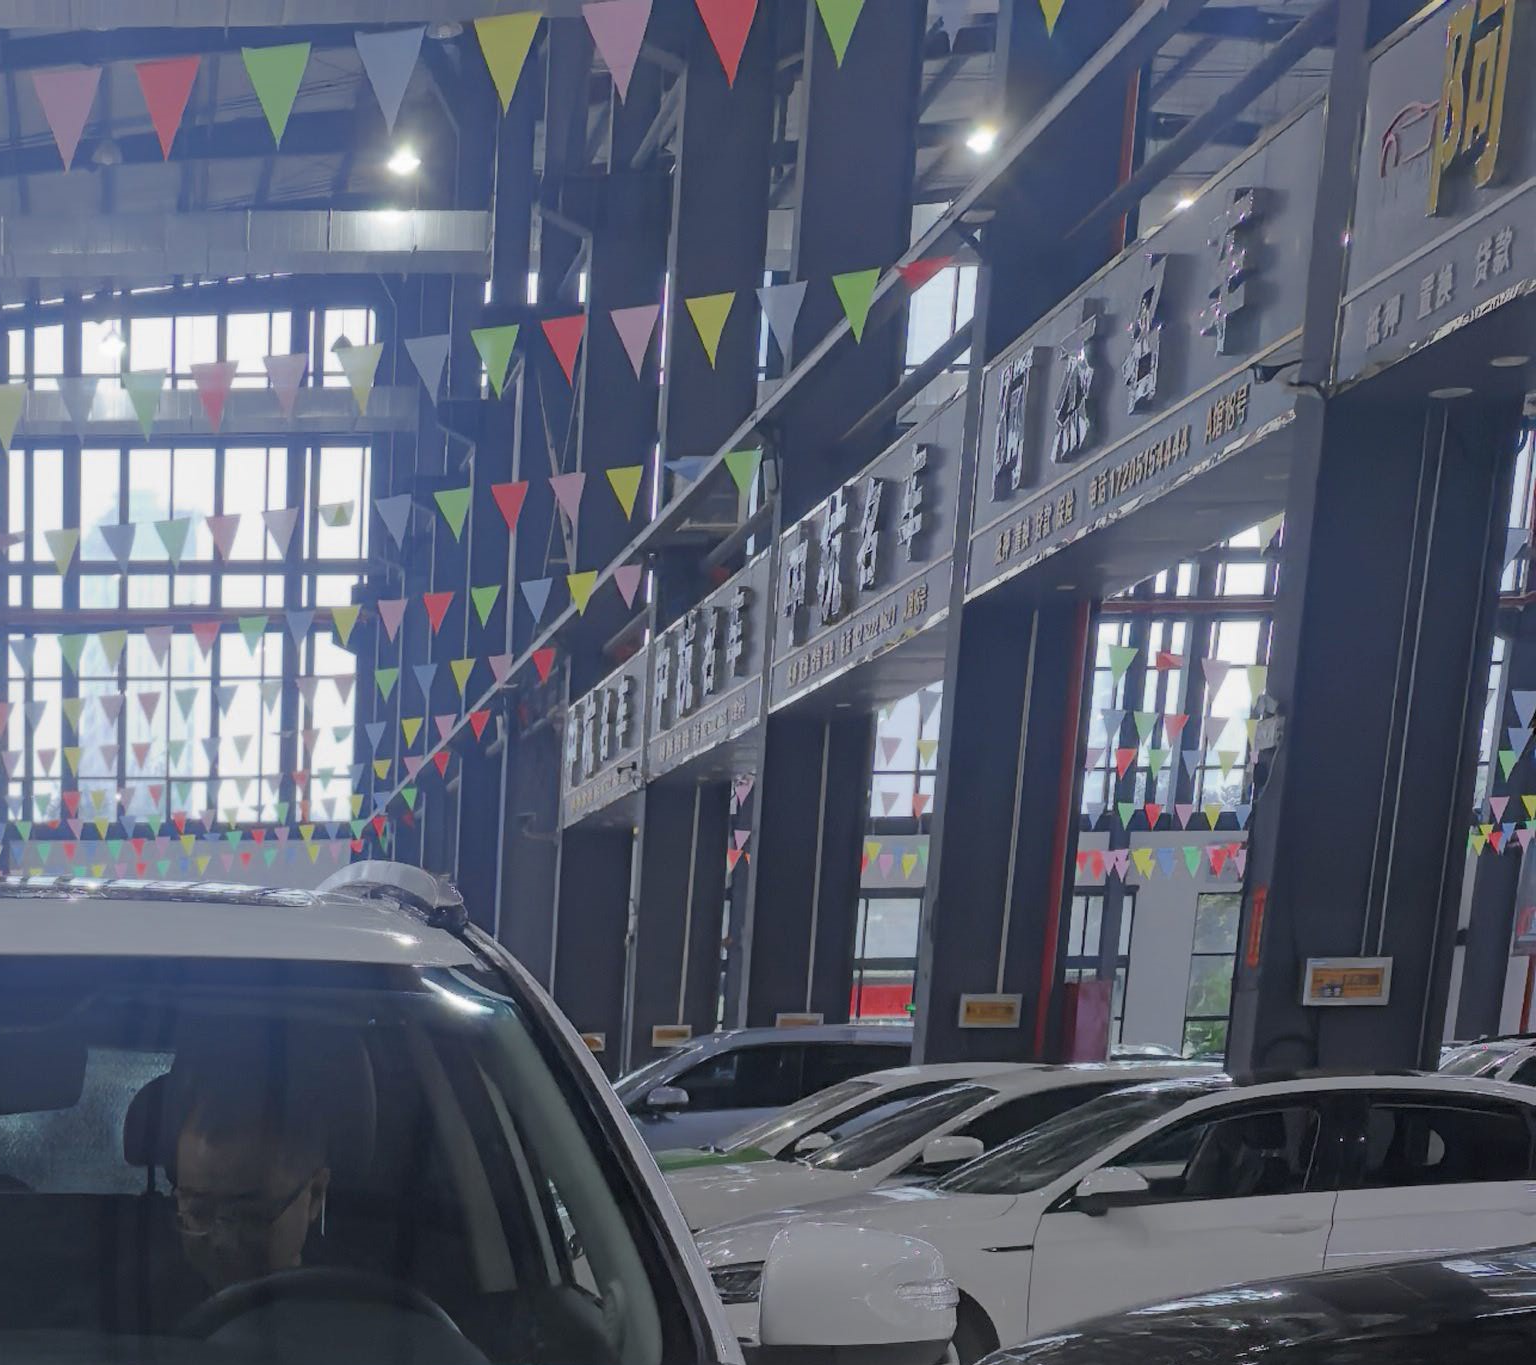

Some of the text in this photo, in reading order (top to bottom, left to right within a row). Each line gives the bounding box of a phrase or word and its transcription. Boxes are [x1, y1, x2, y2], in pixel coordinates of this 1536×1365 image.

[1424, 0, 1512, 217] 阿
[1417, 262, 1455, 321] 置换
[1472, 225, 1513, 289] 贷款
